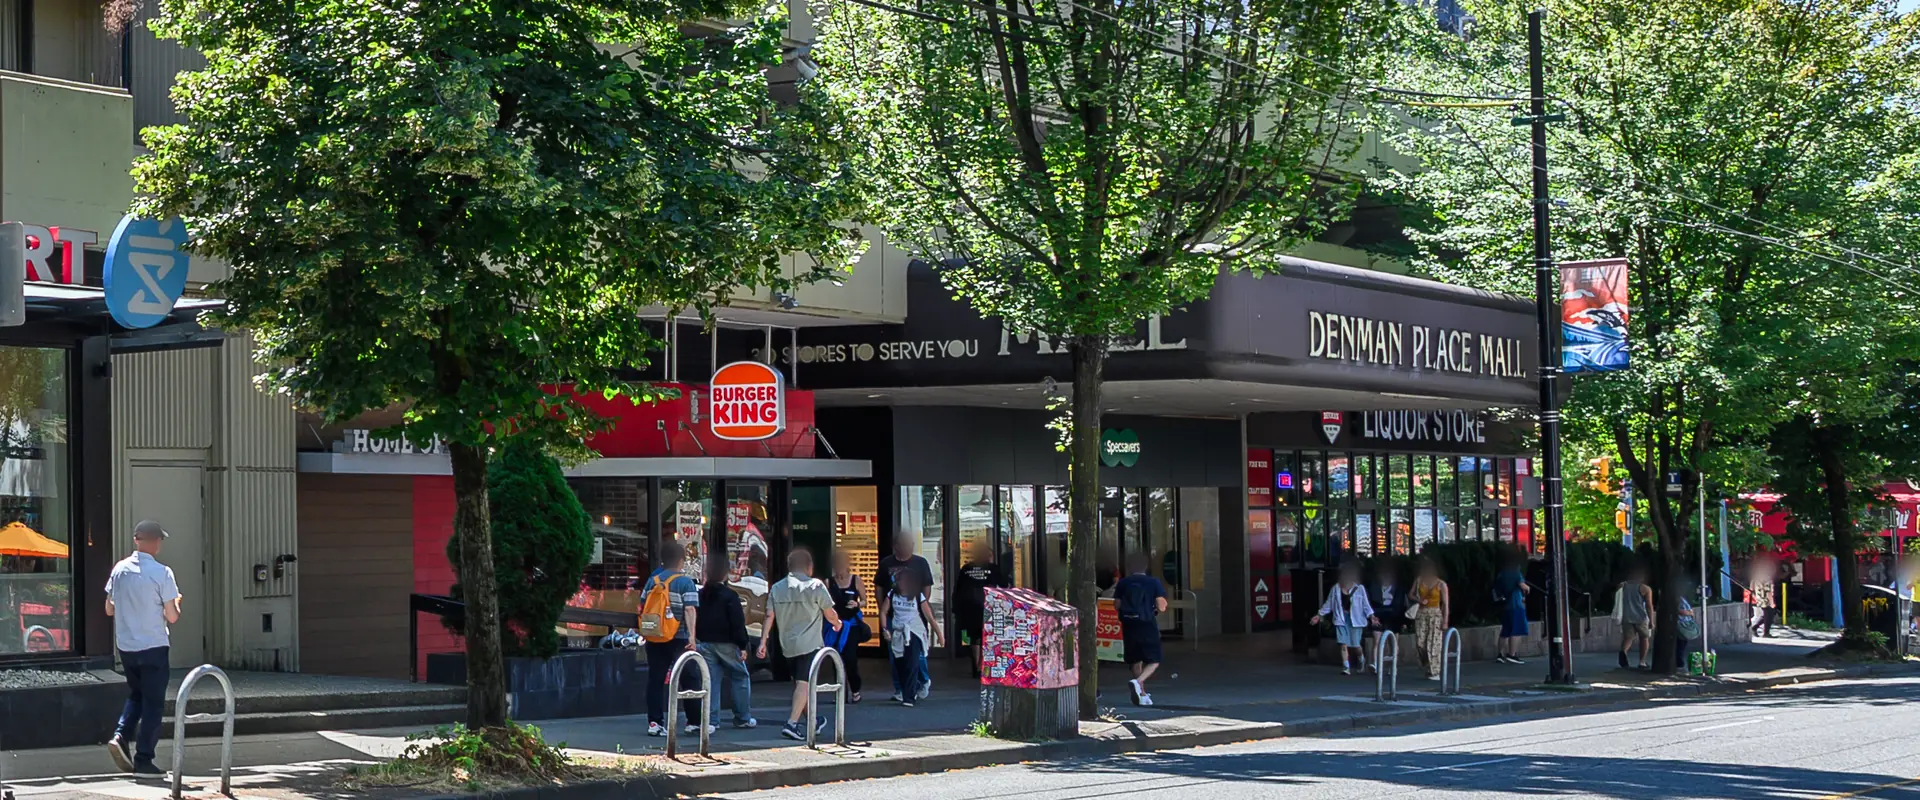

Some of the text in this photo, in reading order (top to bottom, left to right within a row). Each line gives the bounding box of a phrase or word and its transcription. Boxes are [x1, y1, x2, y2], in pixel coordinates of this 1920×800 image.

[848, 343, 875, 362] TO
[879, 340, 935, 361] SERVE
[936, 339, 979, 358] YOU
[1309, 311, 1526, 378] DENMAN PLACE MALL
[713, 386, 777, 402] BURGER
[713, 402, 777, 424] KING
[1364, 409, 1486, 443] LIQUOR STORE
[1107, 440, 1140, 455] Specsavers
[1097, 622, 1121, 635] $99
